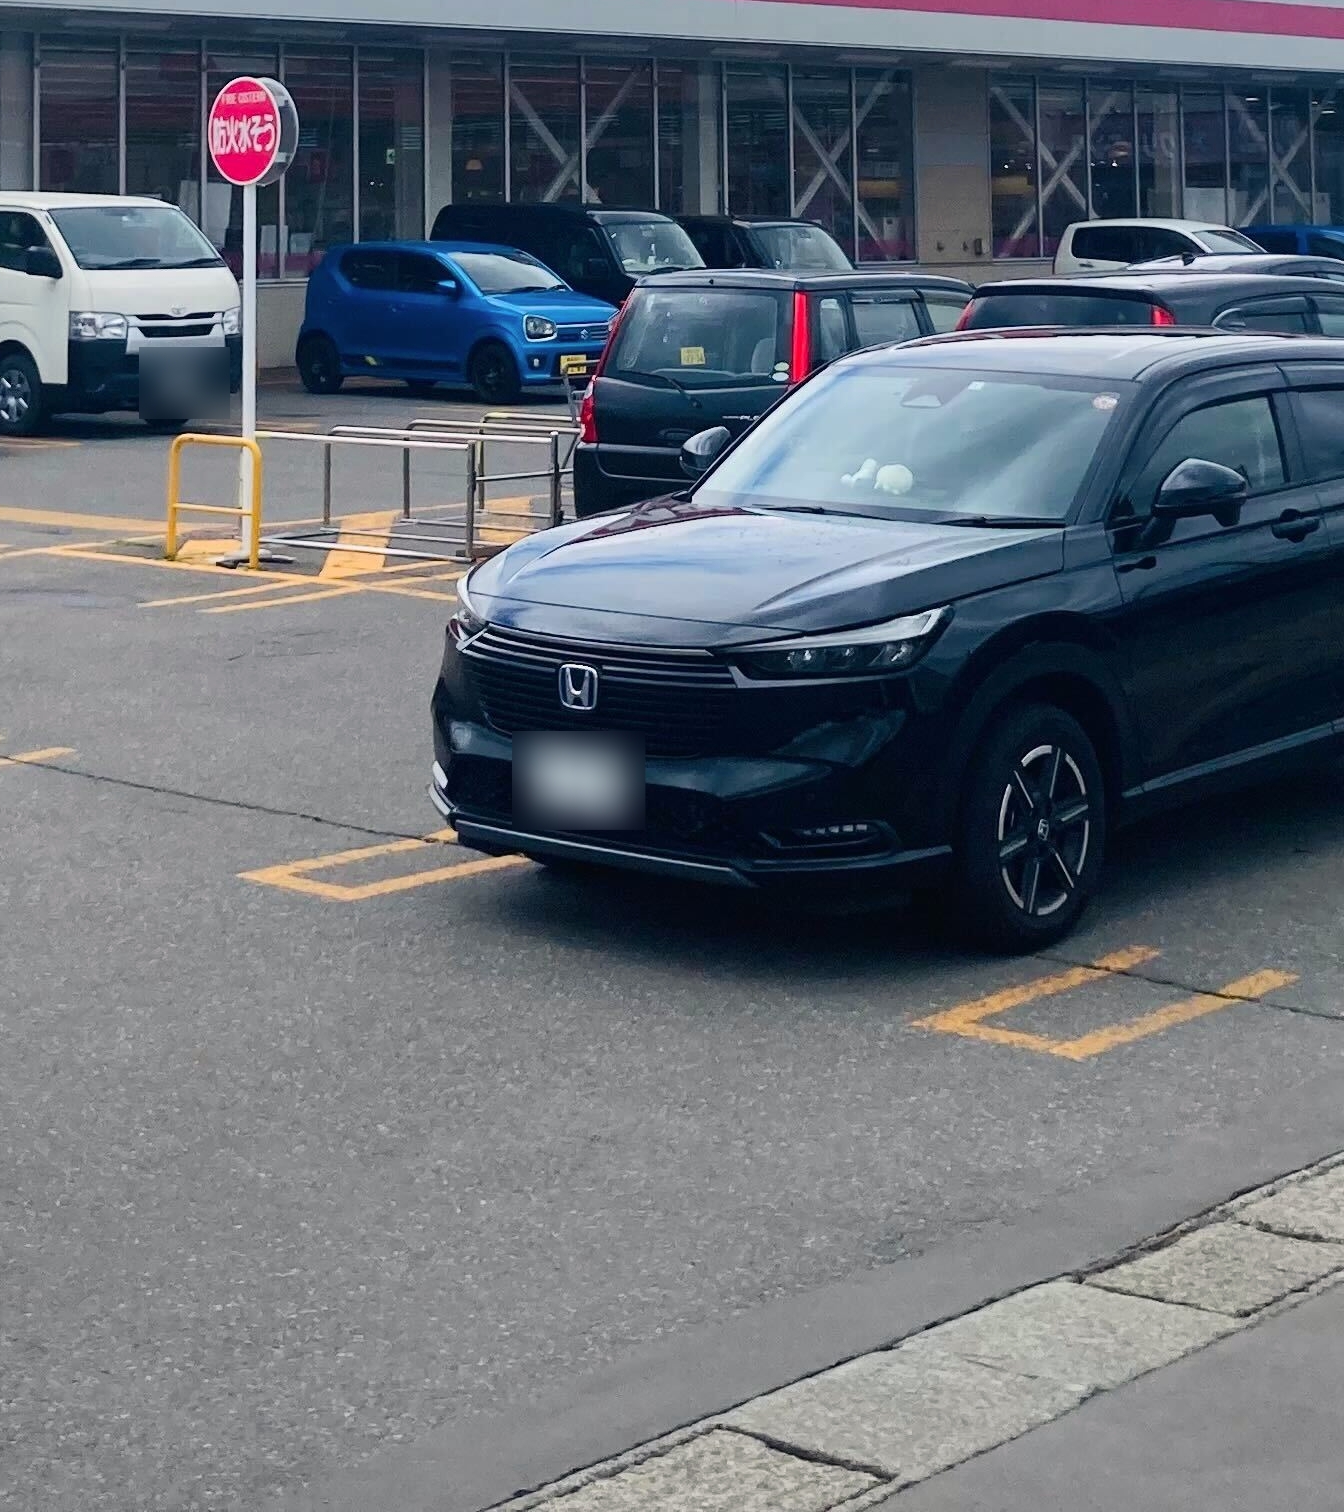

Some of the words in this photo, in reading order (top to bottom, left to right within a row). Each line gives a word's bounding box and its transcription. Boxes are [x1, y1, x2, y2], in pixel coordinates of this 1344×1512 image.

[213, 114, 275, 155] 防火水そう
